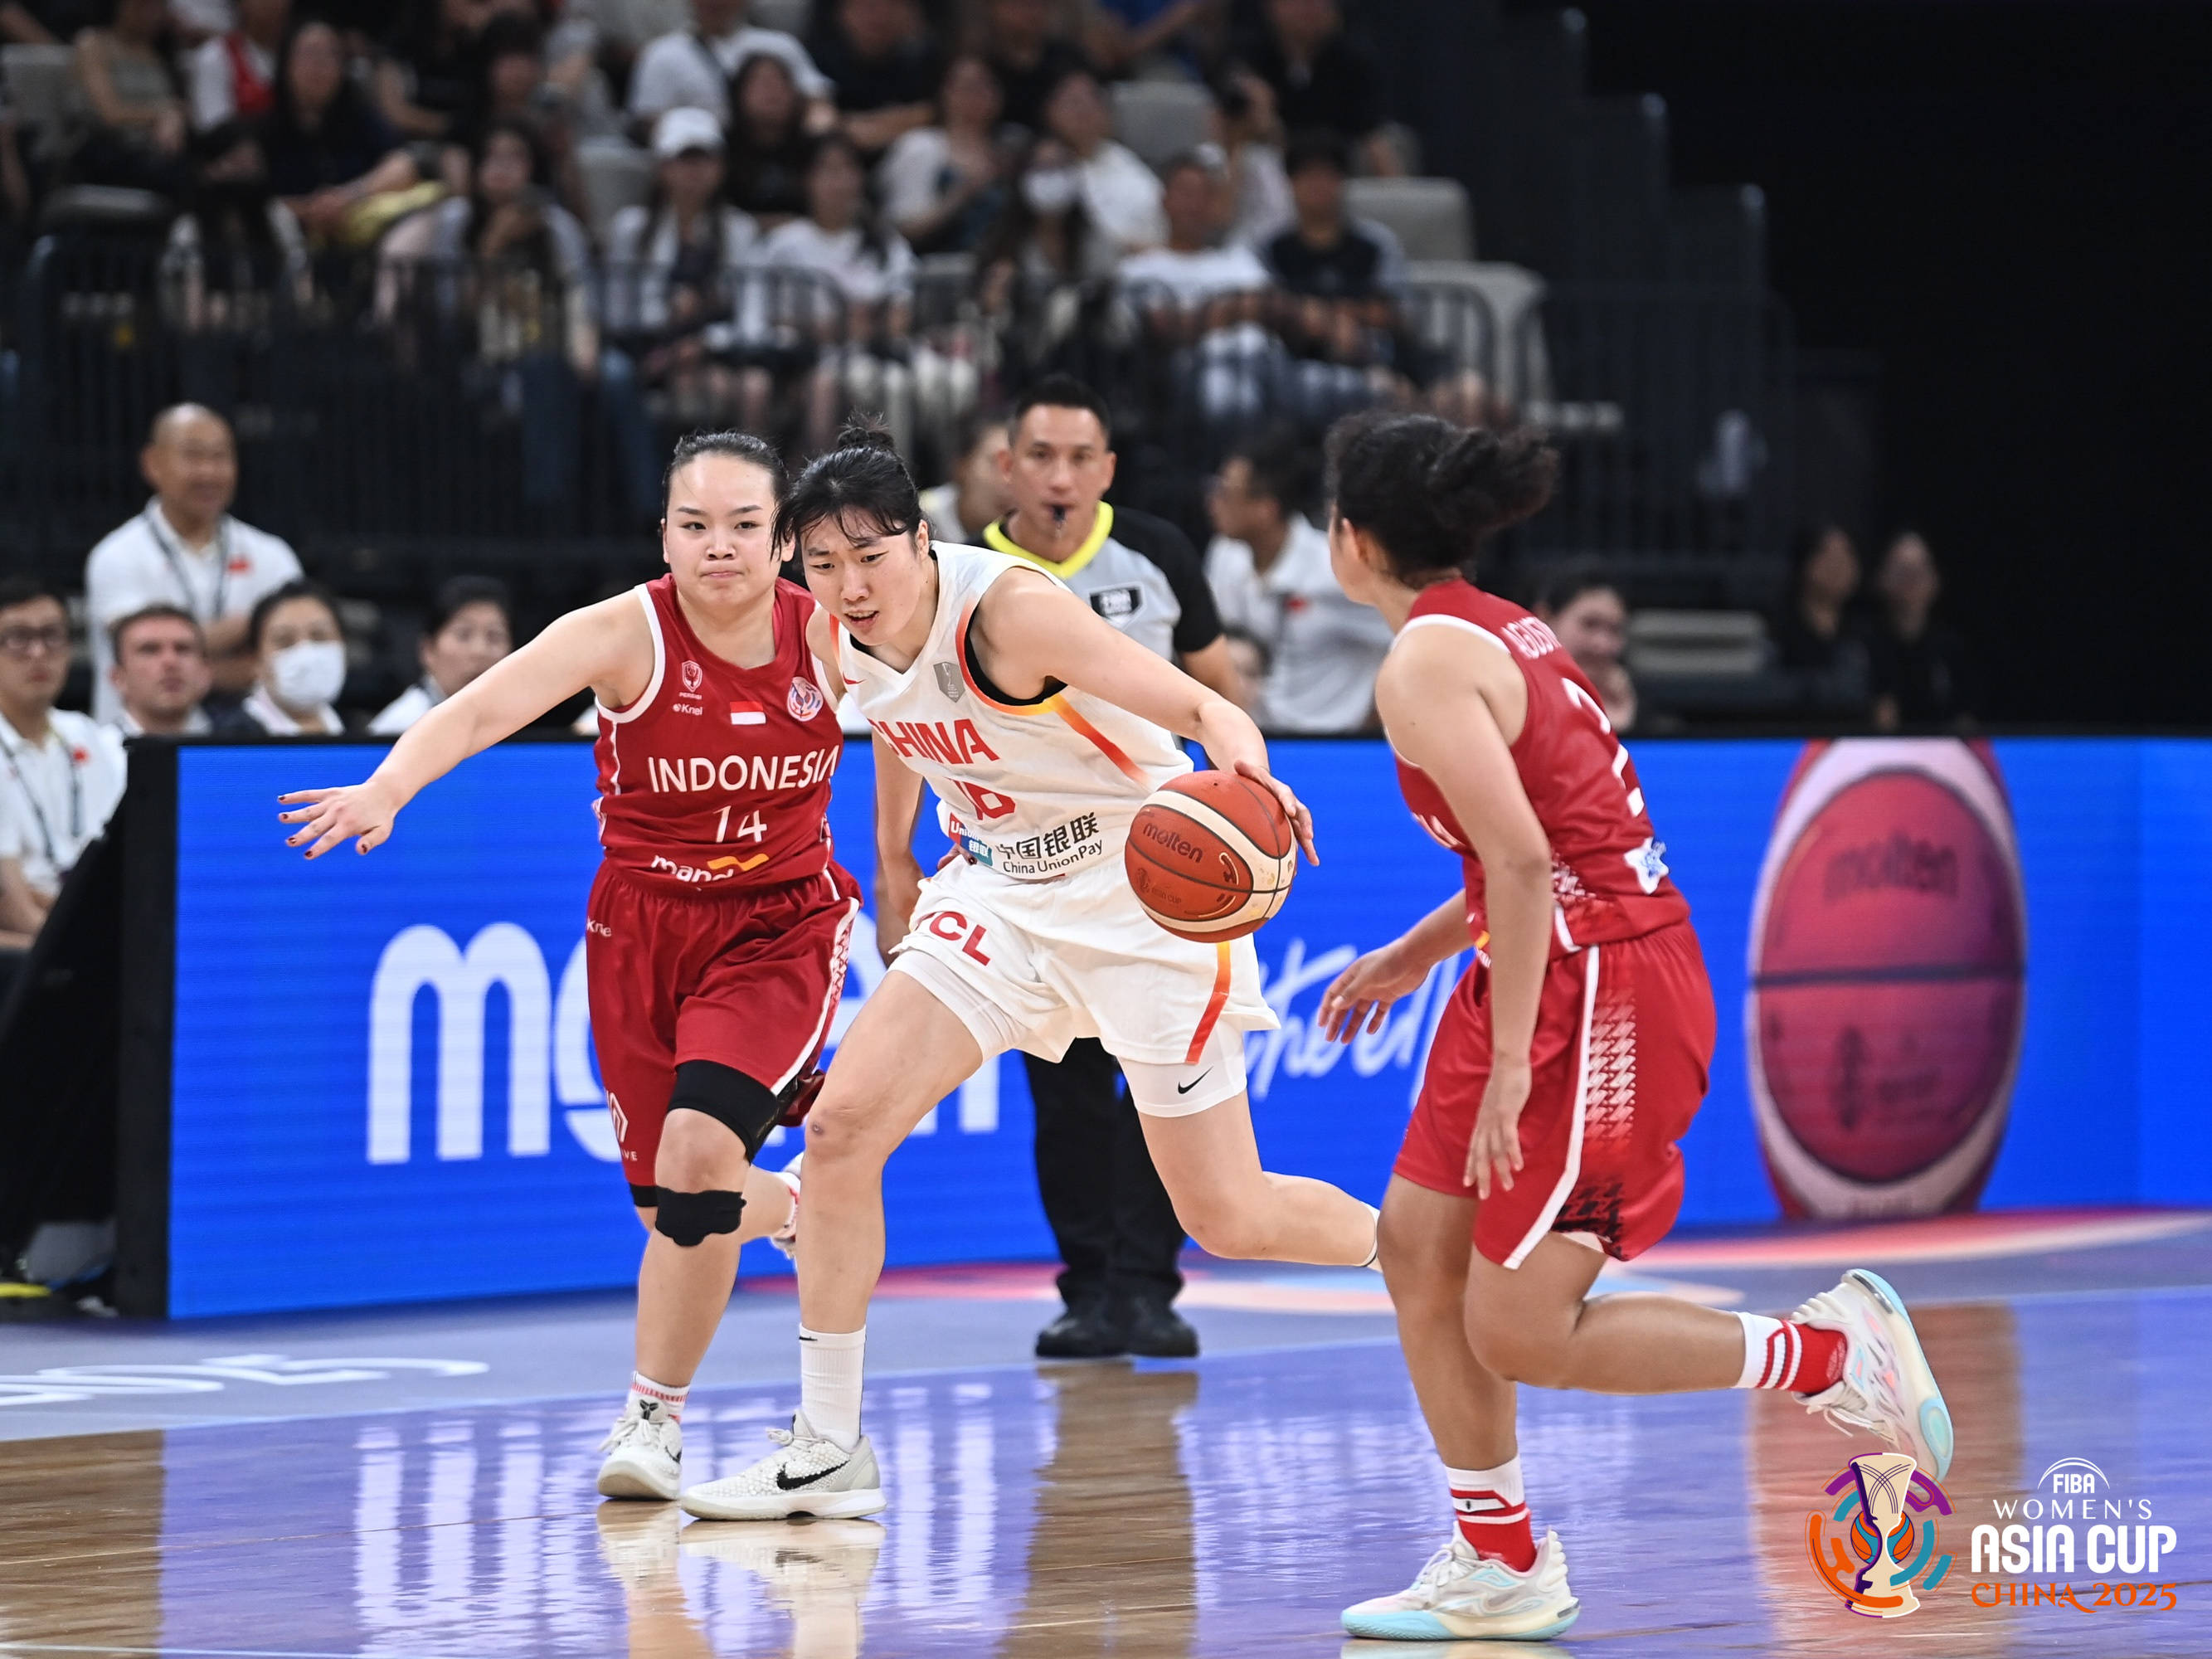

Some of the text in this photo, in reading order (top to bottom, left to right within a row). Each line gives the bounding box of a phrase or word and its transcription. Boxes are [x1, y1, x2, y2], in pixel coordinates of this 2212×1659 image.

[648, 745, 839, 793] INDONESIA
[712, 805, 767, 844] 14
[1143, 822, 1203, 864] molten
[1003, 839, 1102, 874] China UnionPay
[917, 911, 990, 966] CL
